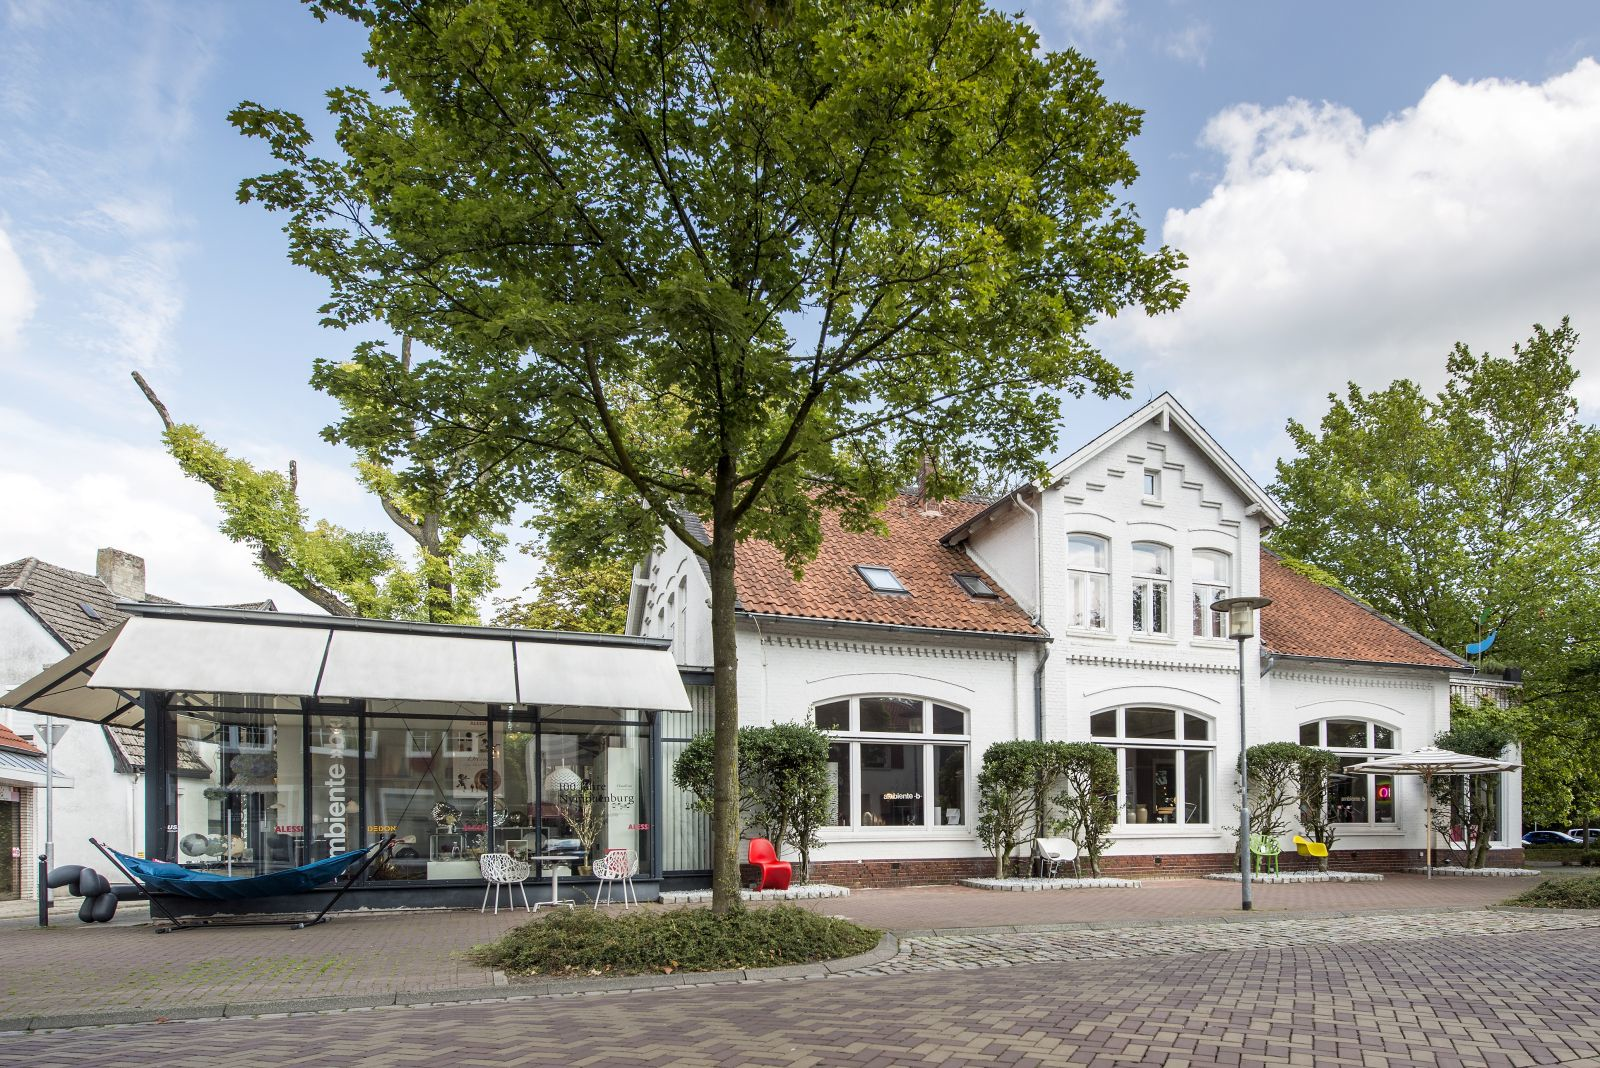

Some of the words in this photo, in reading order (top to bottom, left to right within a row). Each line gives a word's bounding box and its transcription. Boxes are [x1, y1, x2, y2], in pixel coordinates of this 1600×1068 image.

[883, 792, 913, 800] abiente
[323, 763, 346, 858] mbiente
[275, 825, 304, 833] ALESSI
